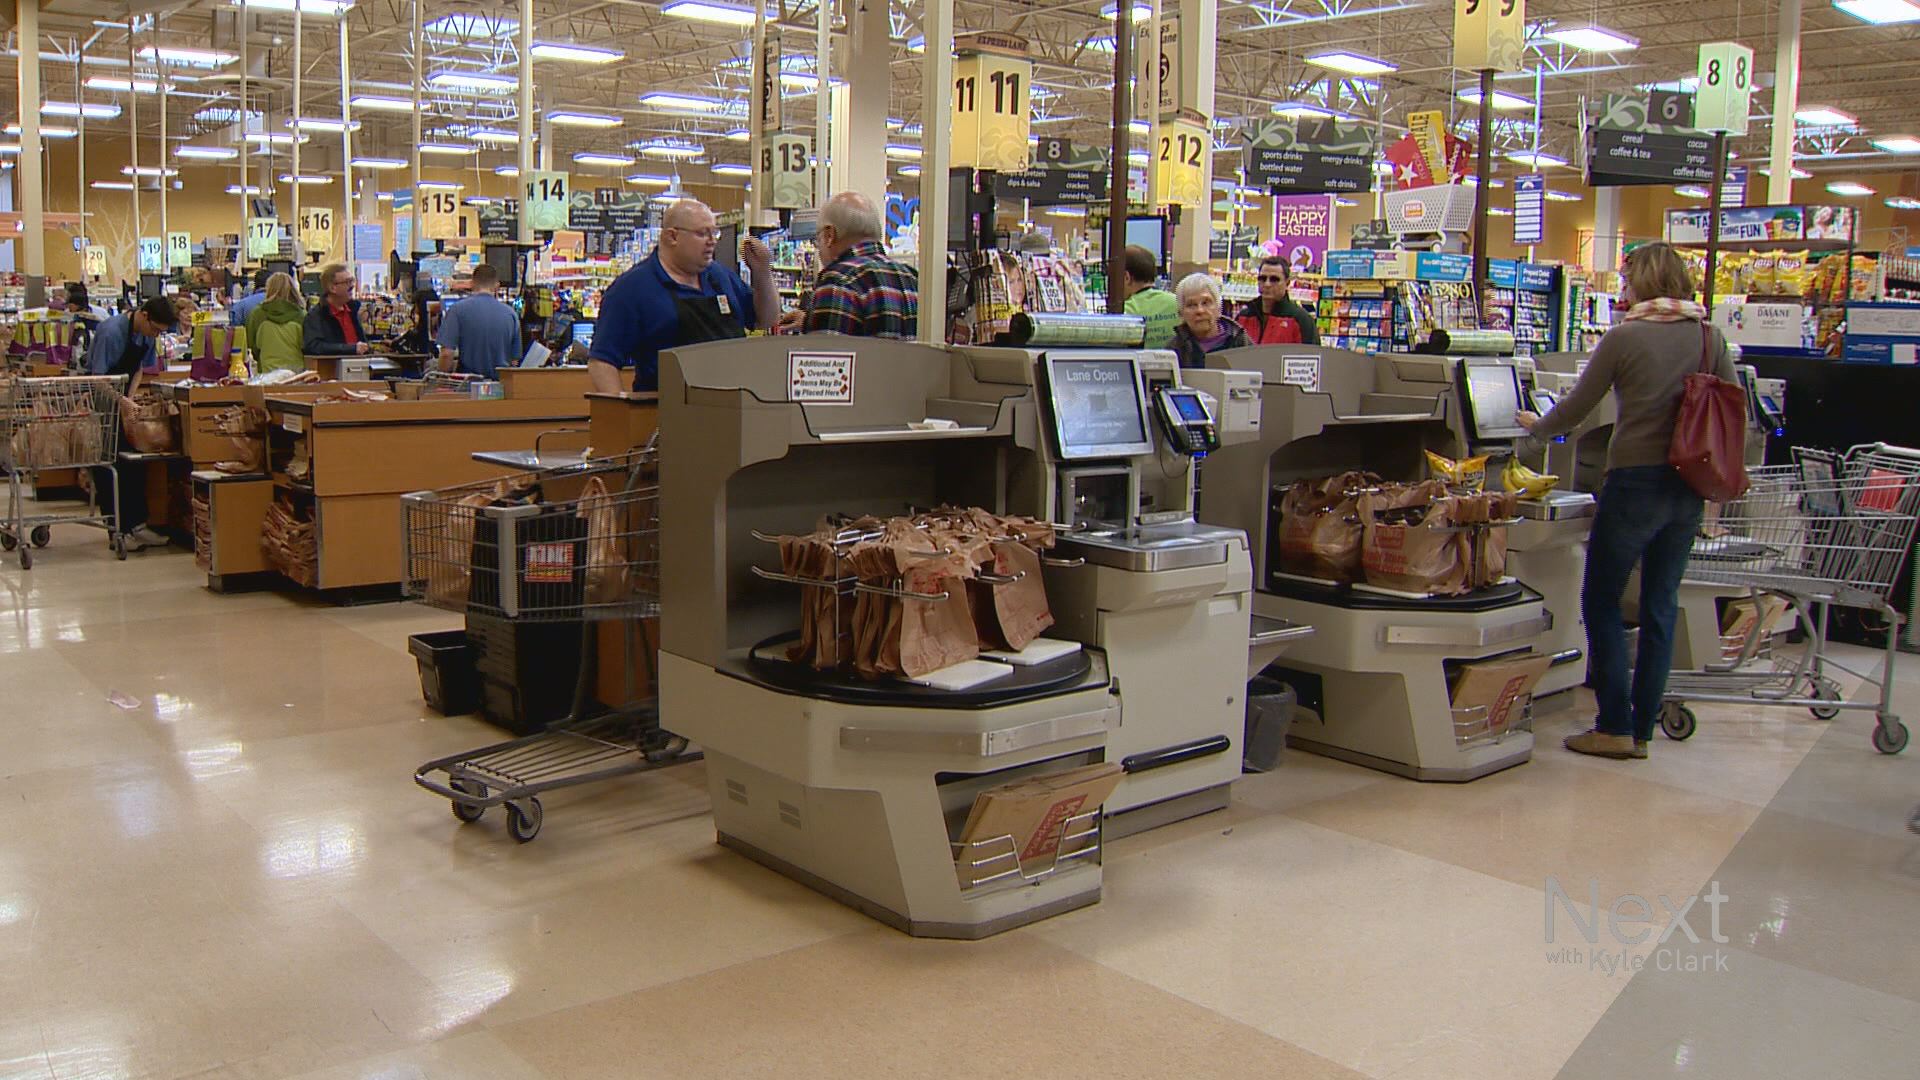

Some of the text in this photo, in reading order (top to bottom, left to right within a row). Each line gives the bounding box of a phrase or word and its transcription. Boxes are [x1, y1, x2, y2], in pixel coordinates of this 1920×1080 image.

[977, 36, 1026, 51] EXPRESS LANE
[1708, 59, 1720, 86] 8
[1736, 56, 1746, 89] 8
[956, 77, 975, 112] 11
[990, 71, 1020, 115] 11
[1662, 96, 1678, 119] 6
[1311, 120, 1322, 138] 7
[1622, 134, 1643, 143] cereal
[1687, 140, 1707, 149] cocoa
[1048, 141, 1060, 158] 8
[1159, 137, 1170, 161] 2
[1177, 133, 1202, 167] 12
[1262, 151, 1303, 161] sports drinks
[1610, 147, 1651, 159] coffee & tea
[761, 148, 771, 173] 13
[778, 143, 806, 173] 13
[1321, 156, 1363, 165] energy drinks
[1686, 155, 1705, 164] syrup
[1260, 162, 1303, 173] bottled water
[1673, 167, 1694, 177] coffee
[1068, 171, 1089, 179] cookies
[1266, 177, 1280, 185] pop
[540, 179, 565, 201] 14
[1066, 181, 1089, 189] crackers
[1338, 180, 1357, 188] drinks
[433, 193, 455, 213] 15
[600, 190, 614, 203] 11
[301, 215, 310, 230] 16
[313, 213, 330, 230] 16
[1280, 211, 1327, 225] HAPPY
[1696, 213, 1727, 228] TAE
[257, 223, 274, 238] 17
[1279, 225, 1326, 236] EASTER!
[1376, 221, 1383, 232] 9
[1704, 224, 1761, 238] STHING FUN
[148, 243, 160, 255] 19
[171, 236, 187, 249] 18
[89, 251, 103, 260] 20
[1433, 283, 1471, 298] 5280
[819, 379, 832, 387] May
[1066, 369, 1119, 383] Lane Open
